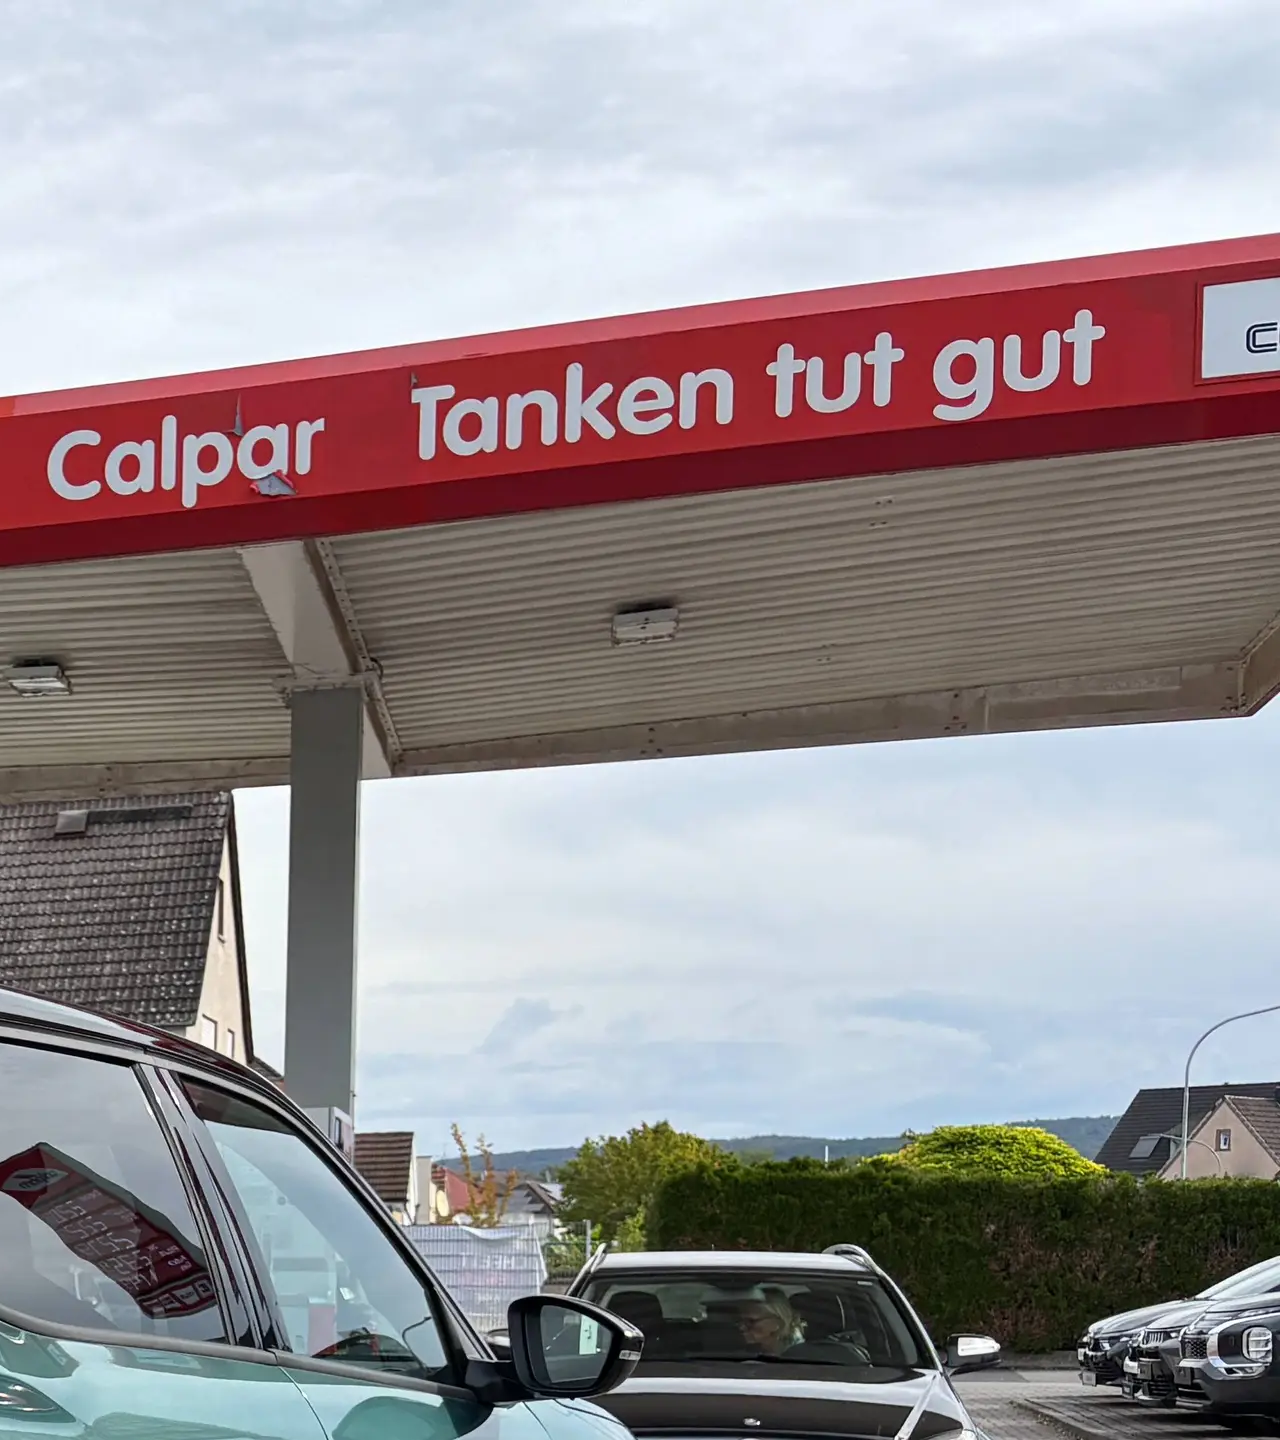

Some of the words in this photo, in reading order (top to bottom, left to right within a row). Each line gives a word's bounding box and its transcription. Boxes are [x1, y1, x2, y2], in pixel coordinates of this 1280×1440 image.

[1246, 321, 1280, 354] C
[47, 414, 325, 508] Calpar
[410, 362, 734, 461] Tanken
[766, 331, 905, 418] tut
[932, 309, 1107, 421] gut
